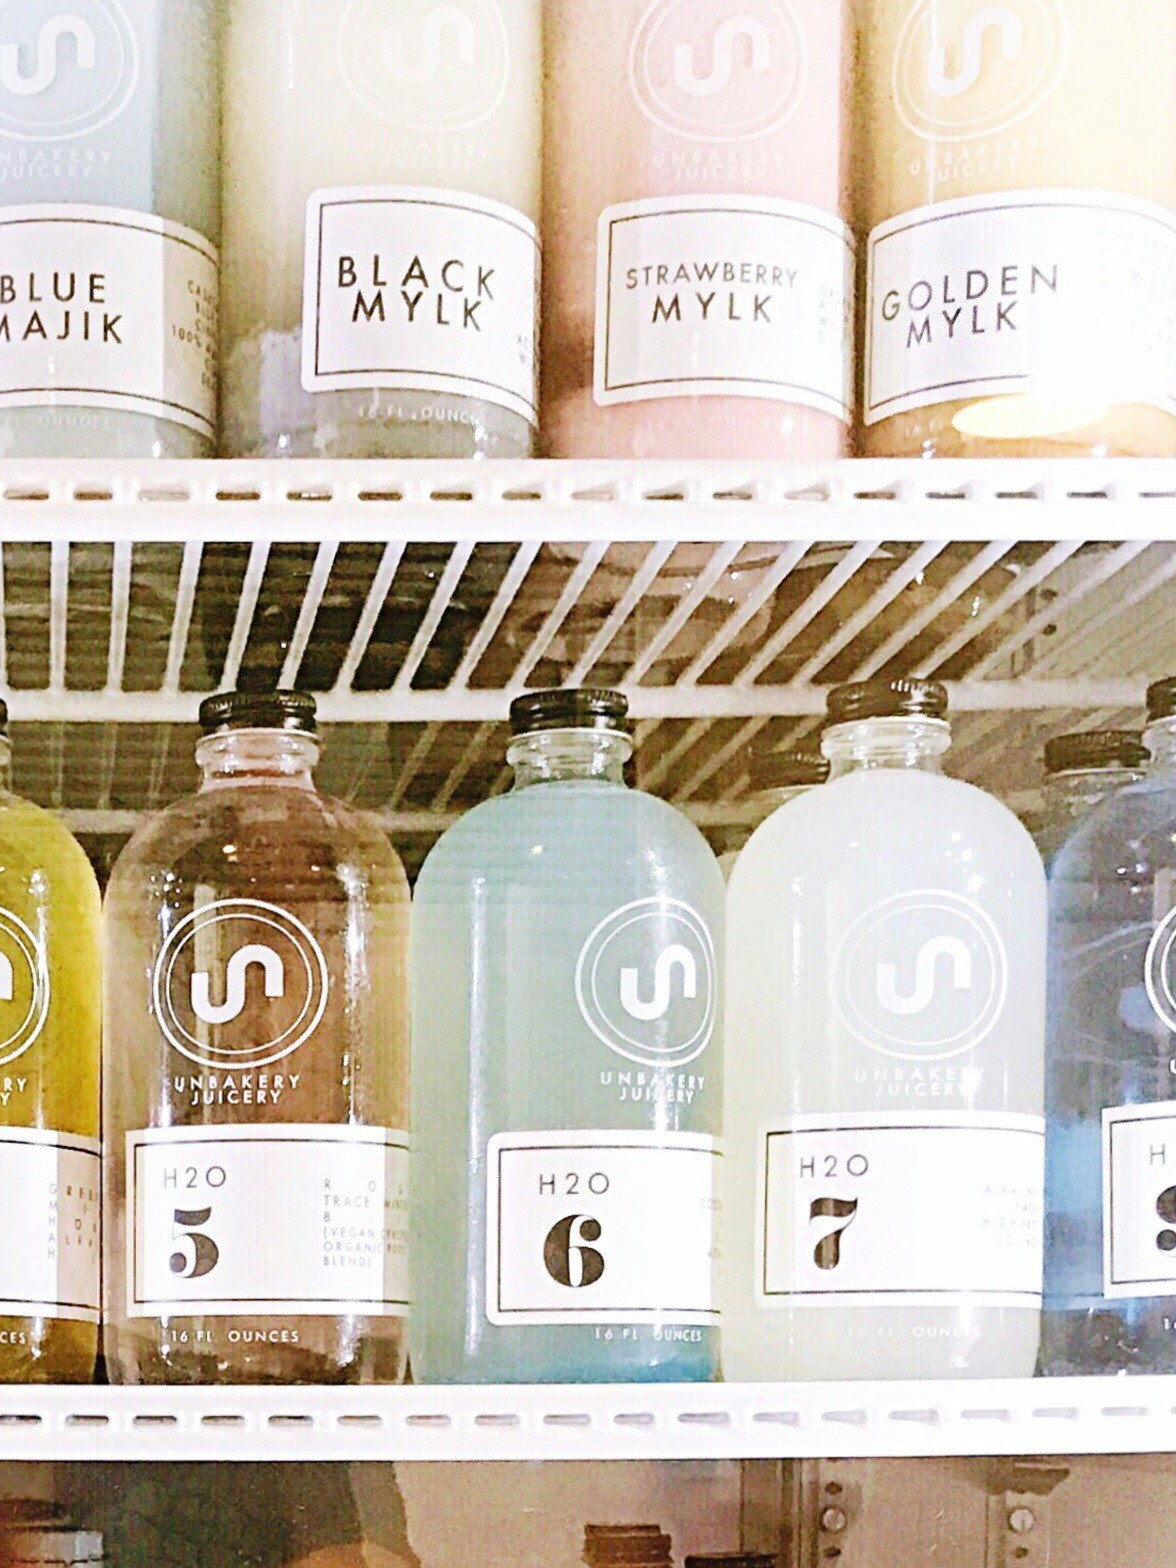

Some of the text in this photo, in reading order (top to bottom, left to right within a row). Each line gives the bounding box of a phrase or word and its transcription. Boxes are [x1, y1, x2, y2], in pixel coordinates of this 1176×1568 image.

[0, 273, 107, 304] BLUE
[338, 255, 497, 302] BLACK
[626, 261, 799, 290] STRAWBERRY
[651, 291, 774, 324] MYLK
[881, 263, 1059, 322] GOLDEN
[352, 290, 483, 333] MYLK
[905, 301, 1019, 349] MYLK
[174, 1074, 300, 1092] UNBAKERY
[600, 1071, 705, 1090] UNBAKERY
[191, 1089, 282, 1105] JUICERY
[163, 1165, 227, 1189] H2O
[800, 1153, 869, 1179] H2O
[539, 1172, 610, 1196] H2O
[168, 1204, 219, 1279] 5
[809, 1195, 859, 1271] 7
[543, 1213, 605, 1288] 6
[171, 1330, 188, 1343] 16
[228, 1330, 299, 1343] OUNCES
[594, 1328, 613, 1340] 16
